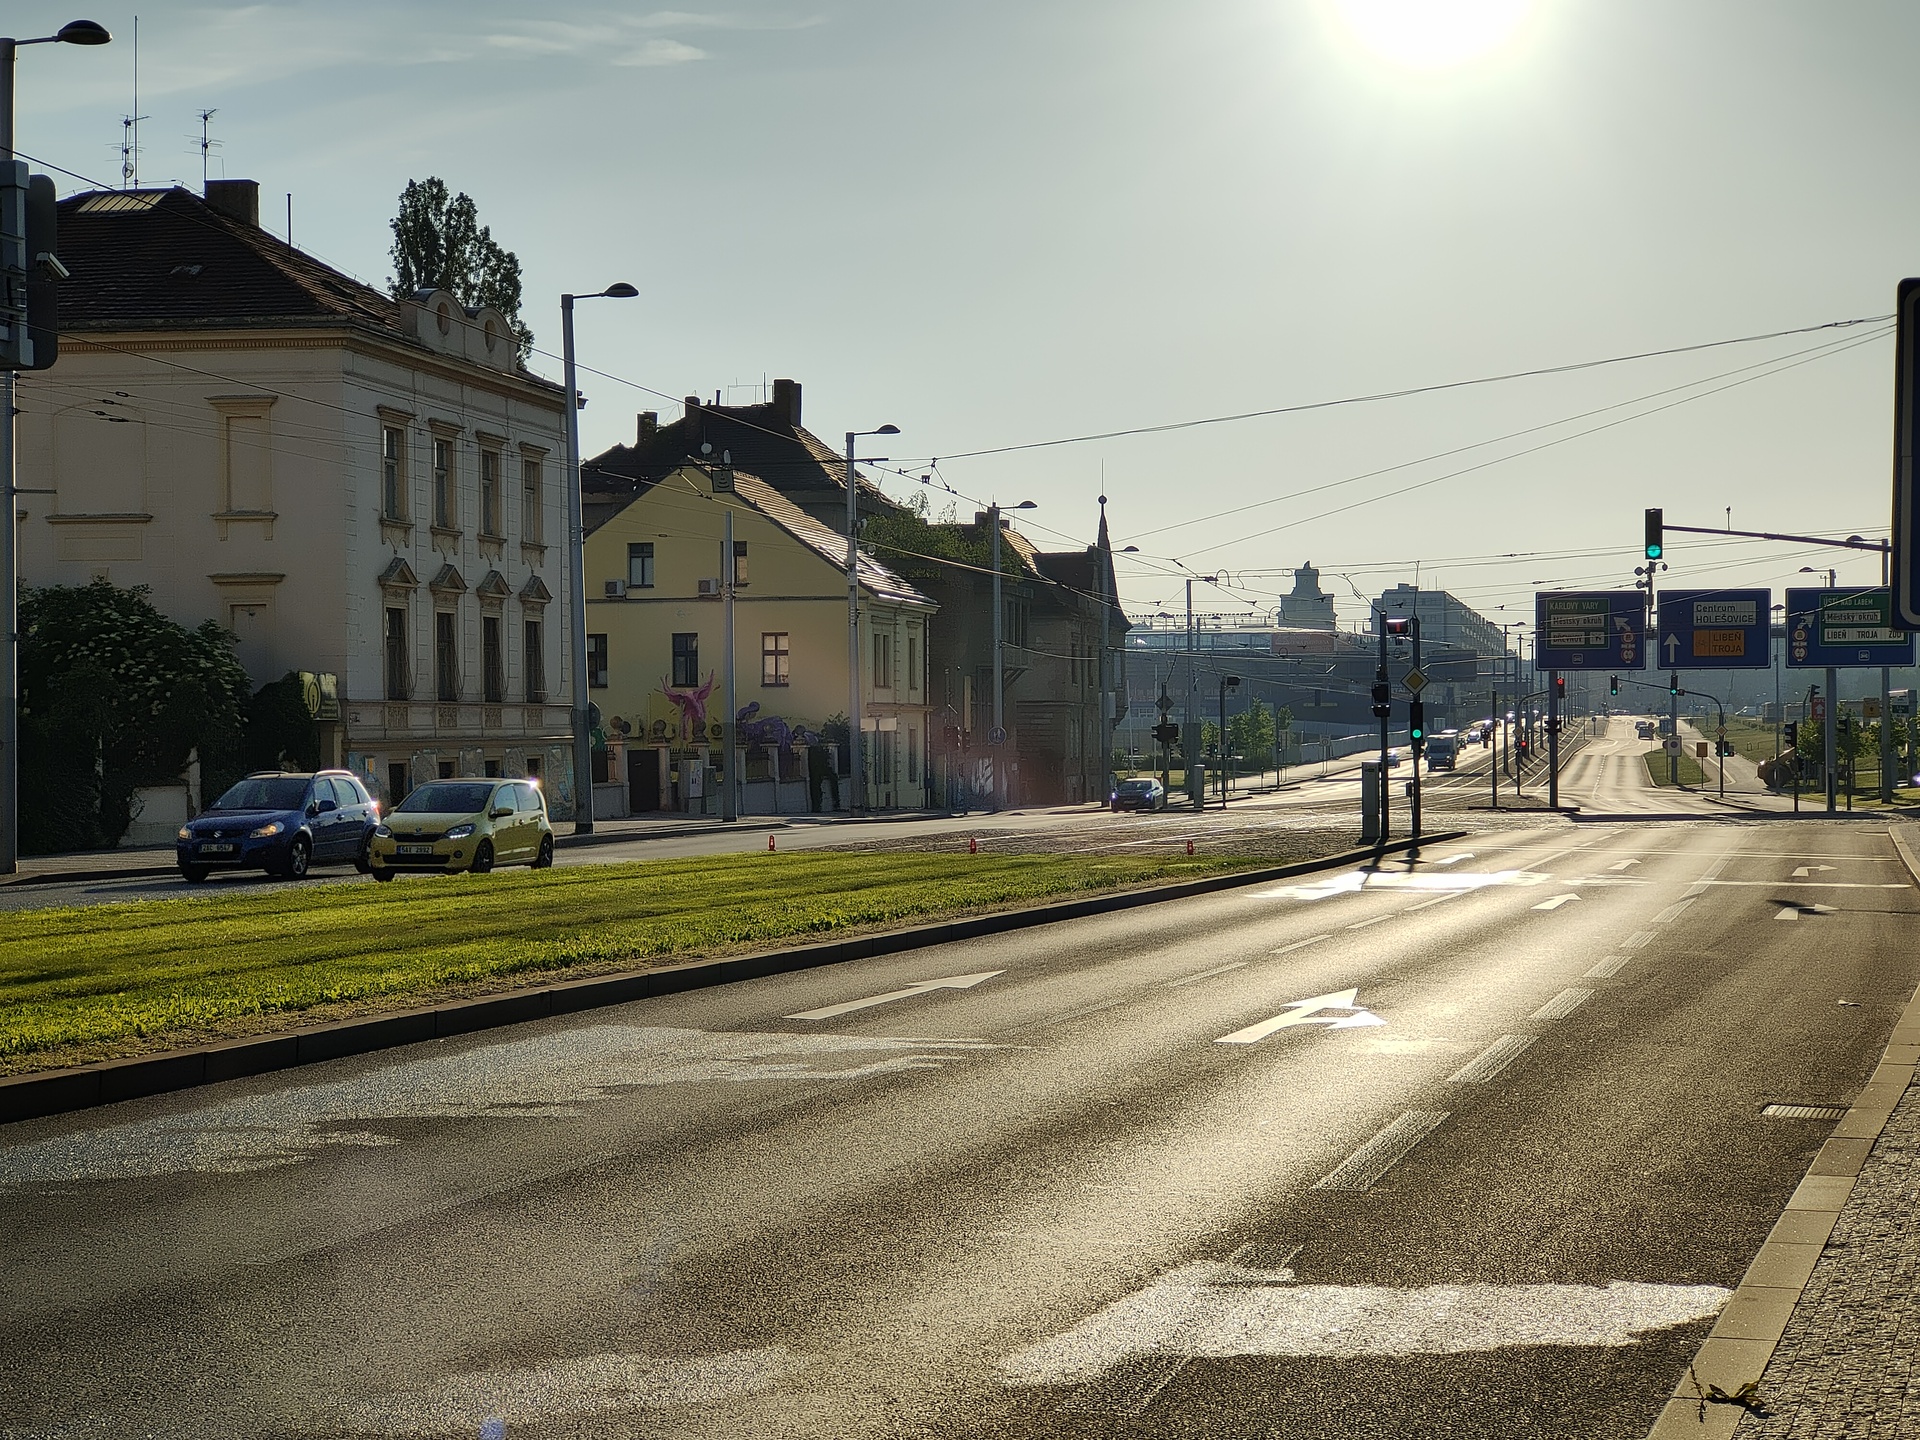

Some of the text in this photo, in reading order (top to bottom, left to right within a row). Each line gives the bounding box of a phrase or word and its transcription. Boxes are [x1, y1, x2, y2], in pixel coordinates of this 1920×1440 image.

[1549, 601, 1599, 610] KARLOVY VARY
[1854, 598, 1873, 606] LABEM
[1696, 604, 1736, 613] Centrum
[1583, 615, 1602, 625] okruh
[1696, 614, 1754, 624] HOLEŠOVICE
[1859, 612, 1878, 621] okruh
[1713, 632, 1741, 642] LIBEŇ
[1827, 629, 1847, 639] LIBEŇ
[1857, 630, 1878, 639] TROJA
[1712, 645, 1742, 653] TROJA
